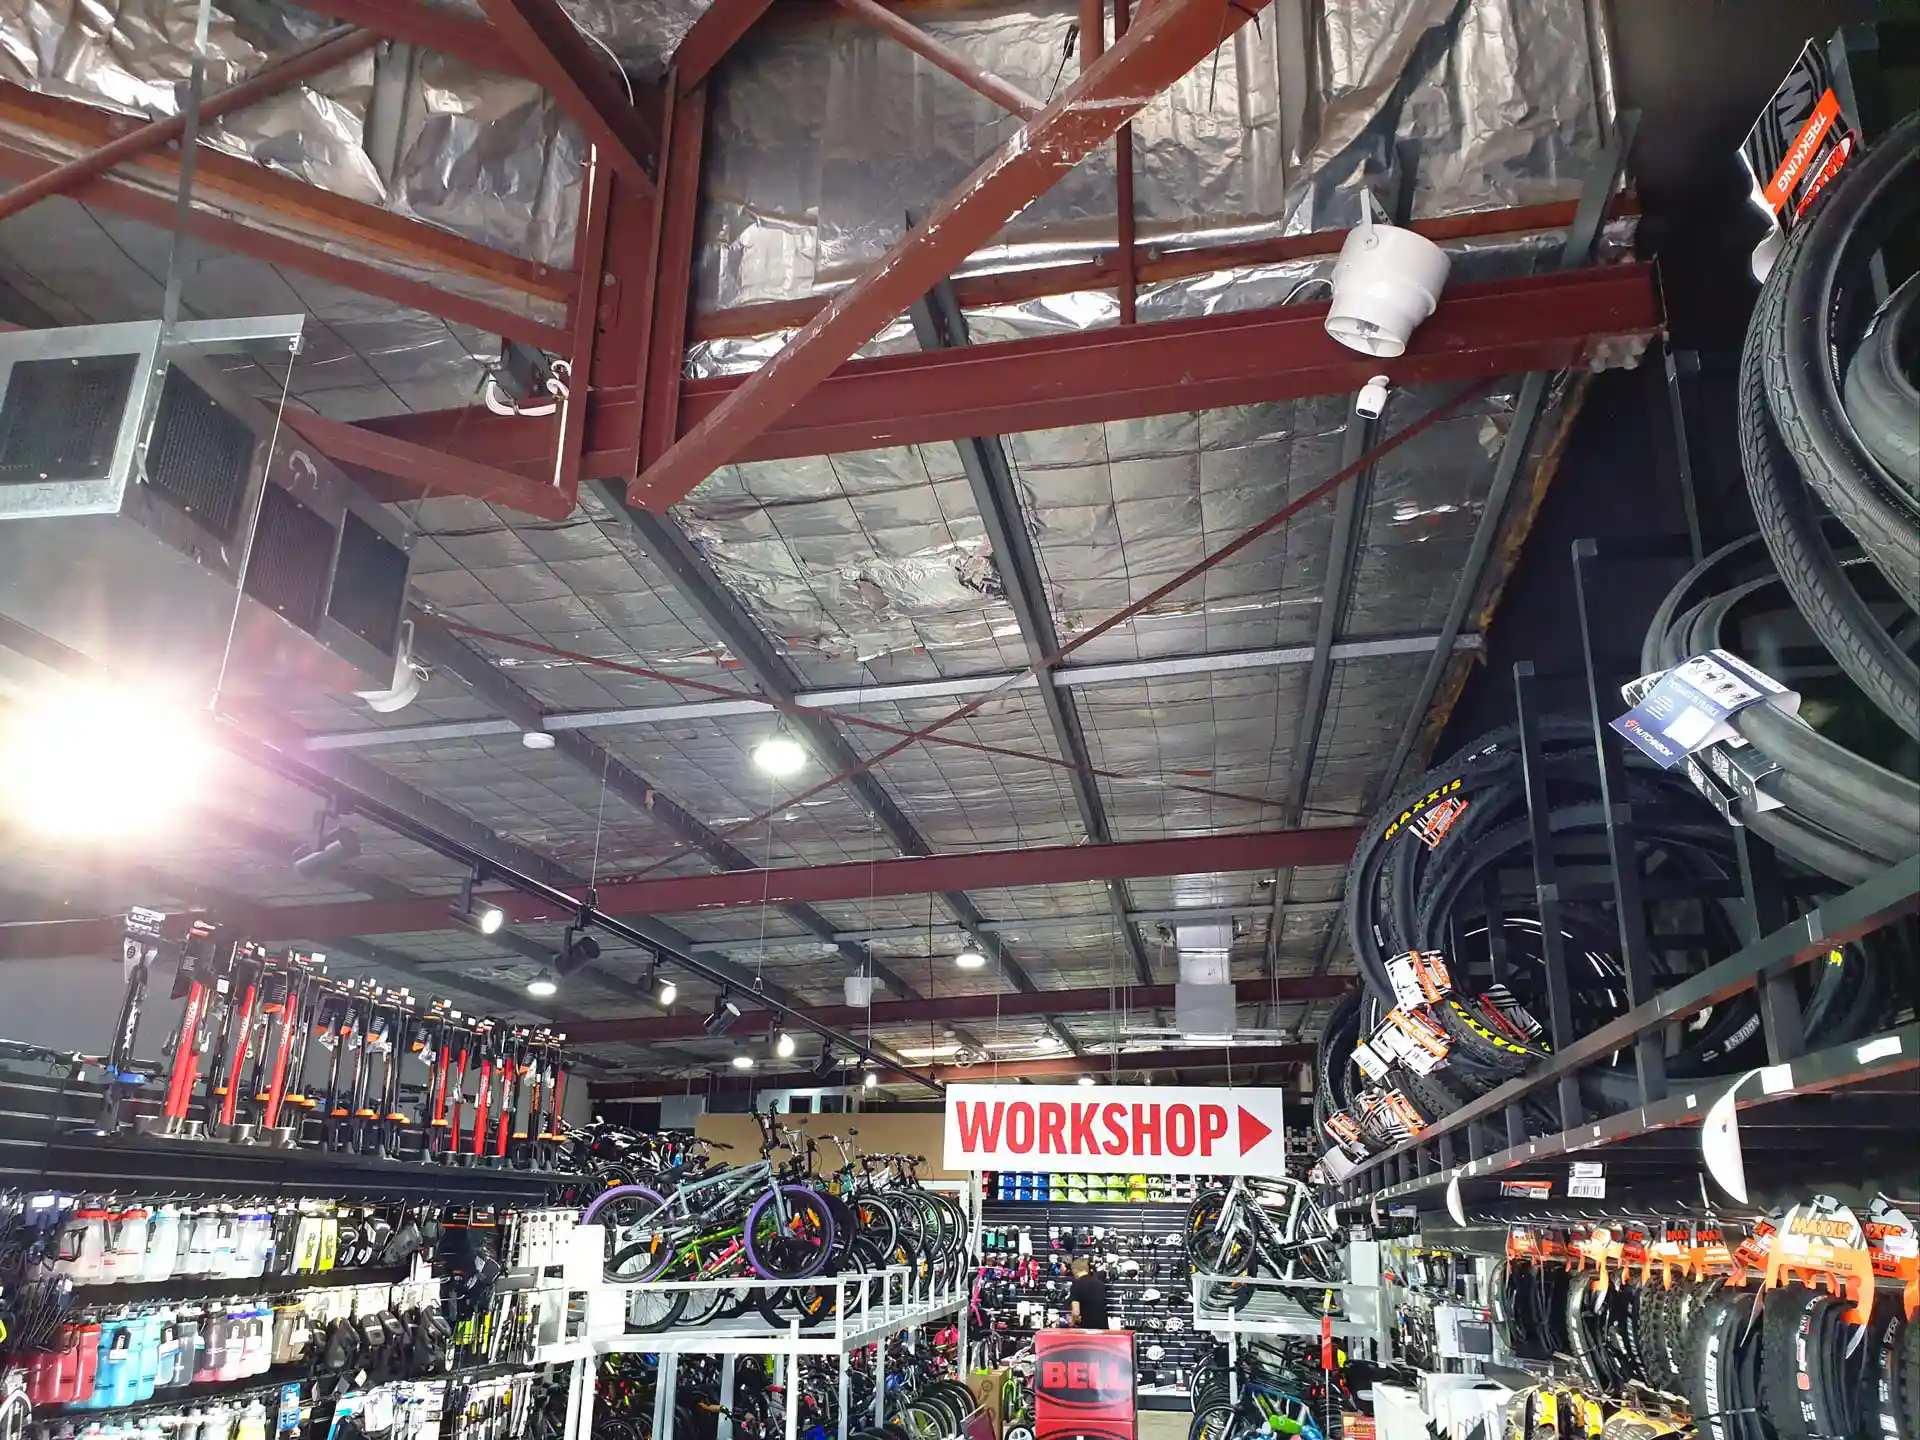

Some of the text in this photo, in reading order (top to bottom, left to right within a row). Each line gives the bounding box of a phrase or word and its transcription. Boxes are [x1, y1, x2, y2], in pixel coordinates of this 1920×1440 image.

[1777, 112, 1827, 192] TREKKING
[1385, 778, 1462, 841] MAXXIS
[956, 1101, 1229, 1157] WORKSHOP
[1042, 1361, 1128, 1390] BELL
